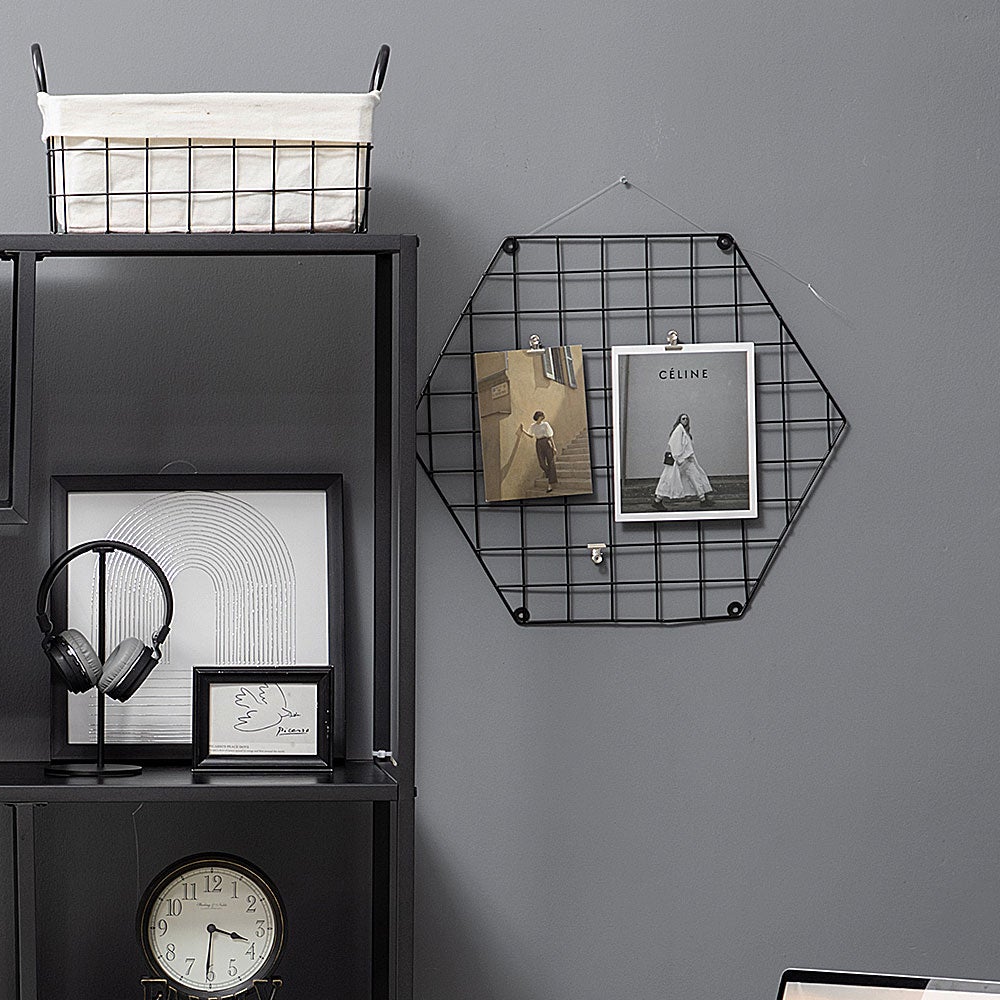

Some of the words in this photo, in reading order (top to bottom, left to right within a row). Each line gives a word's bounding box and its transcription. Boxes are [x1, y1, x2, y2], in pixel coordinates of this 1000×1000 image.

[659, 367, 708, 380] CÉLINE
[182, 882, 197, 900] 11
[204, 874, 223, 892] 12
[231, 881, 239, 898] 1
[165, 898, 182, 916] 10
[245, 895, 257, 913] 2
[158, 919, 168, 937] 9
[255, 920, 265, 937] 3
[166, 943, 176, 961] 8
[245, 942, 256, 960] 4
[185, 958, 195, 975] 7
[206, 964, 215, 981] 6
[227, 959, 238, 976] 5
